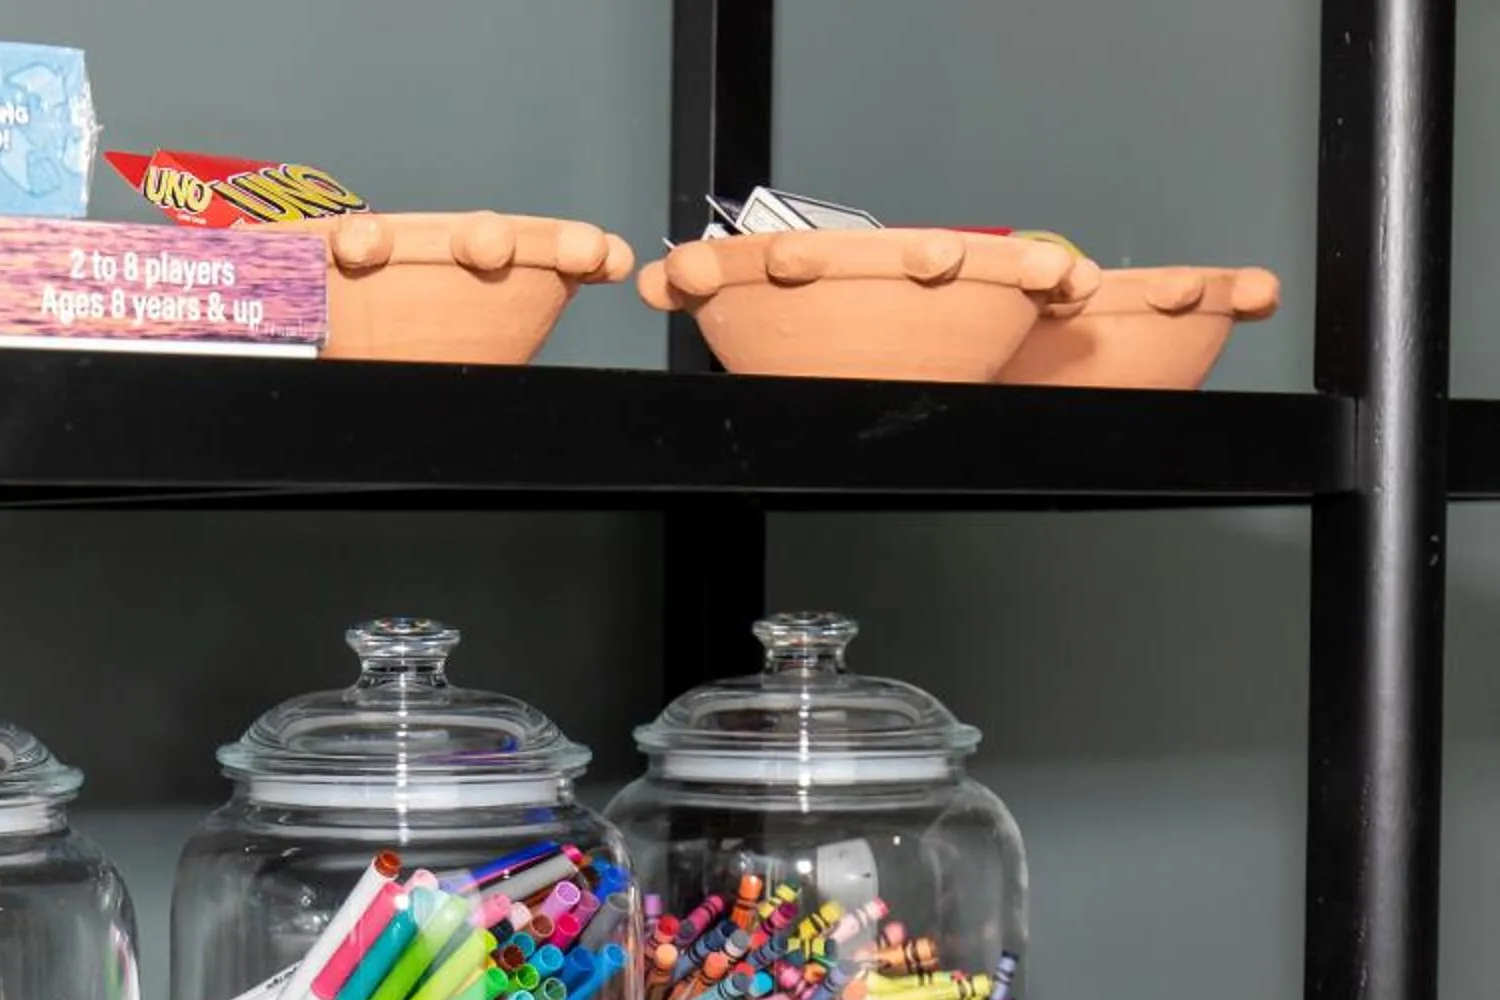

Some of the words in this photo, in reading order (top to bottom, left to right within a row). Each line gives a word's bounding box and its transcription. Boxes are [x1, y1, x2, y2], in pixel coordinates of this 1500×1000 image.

[145, 165, 214, 213] UNO
[212, 164, 367, 223] UNO
[70, 250, 86, 279] 2
[90, 250, 117, 280] to
[123, 252, 139, 281] 8
[145, 252, 236, 292] players
[41, 283, 105, 325] Ages
[111, 289, 126, 319] 8
[132, 294, 201, 326] years
[207, 292, 226, 321] &
[233, 299, 264, 331] up
